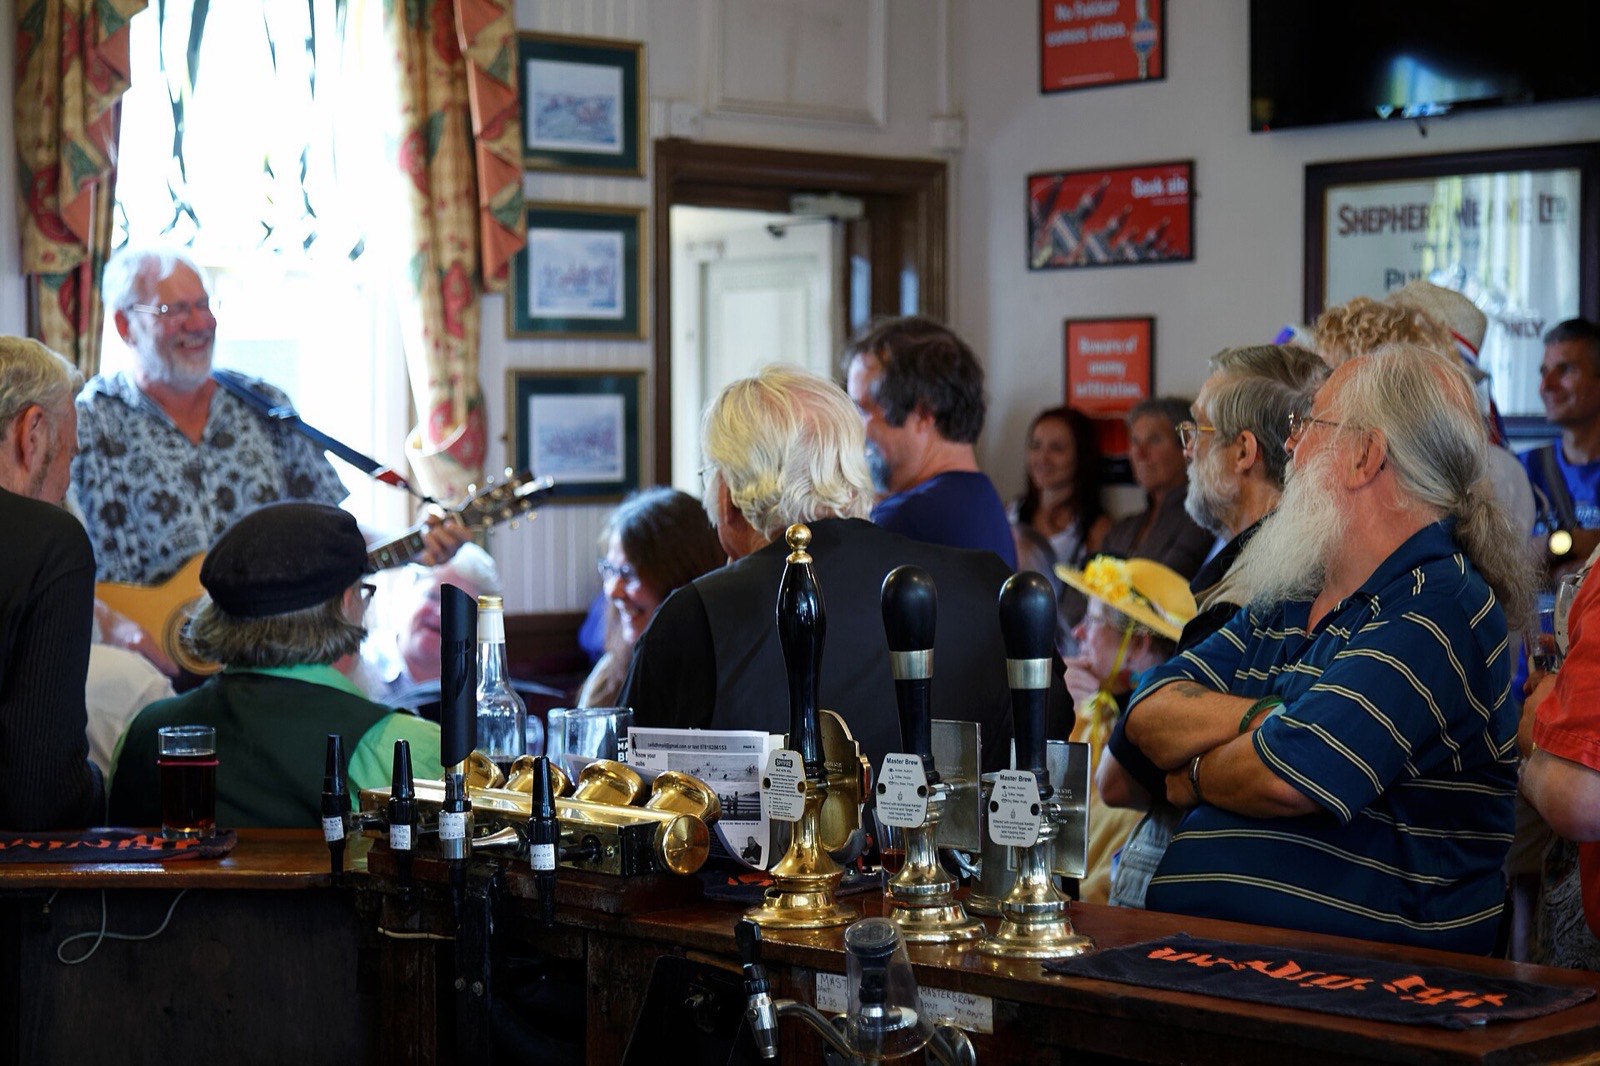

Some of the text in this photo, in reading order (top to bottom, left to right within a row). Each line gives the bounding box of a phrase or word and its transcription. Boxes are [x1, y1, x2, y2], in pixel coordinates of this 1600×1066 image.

[1338, 201, 1440, 237] SHEPHER
[1000, 774, 1032, 783] Master Brew
